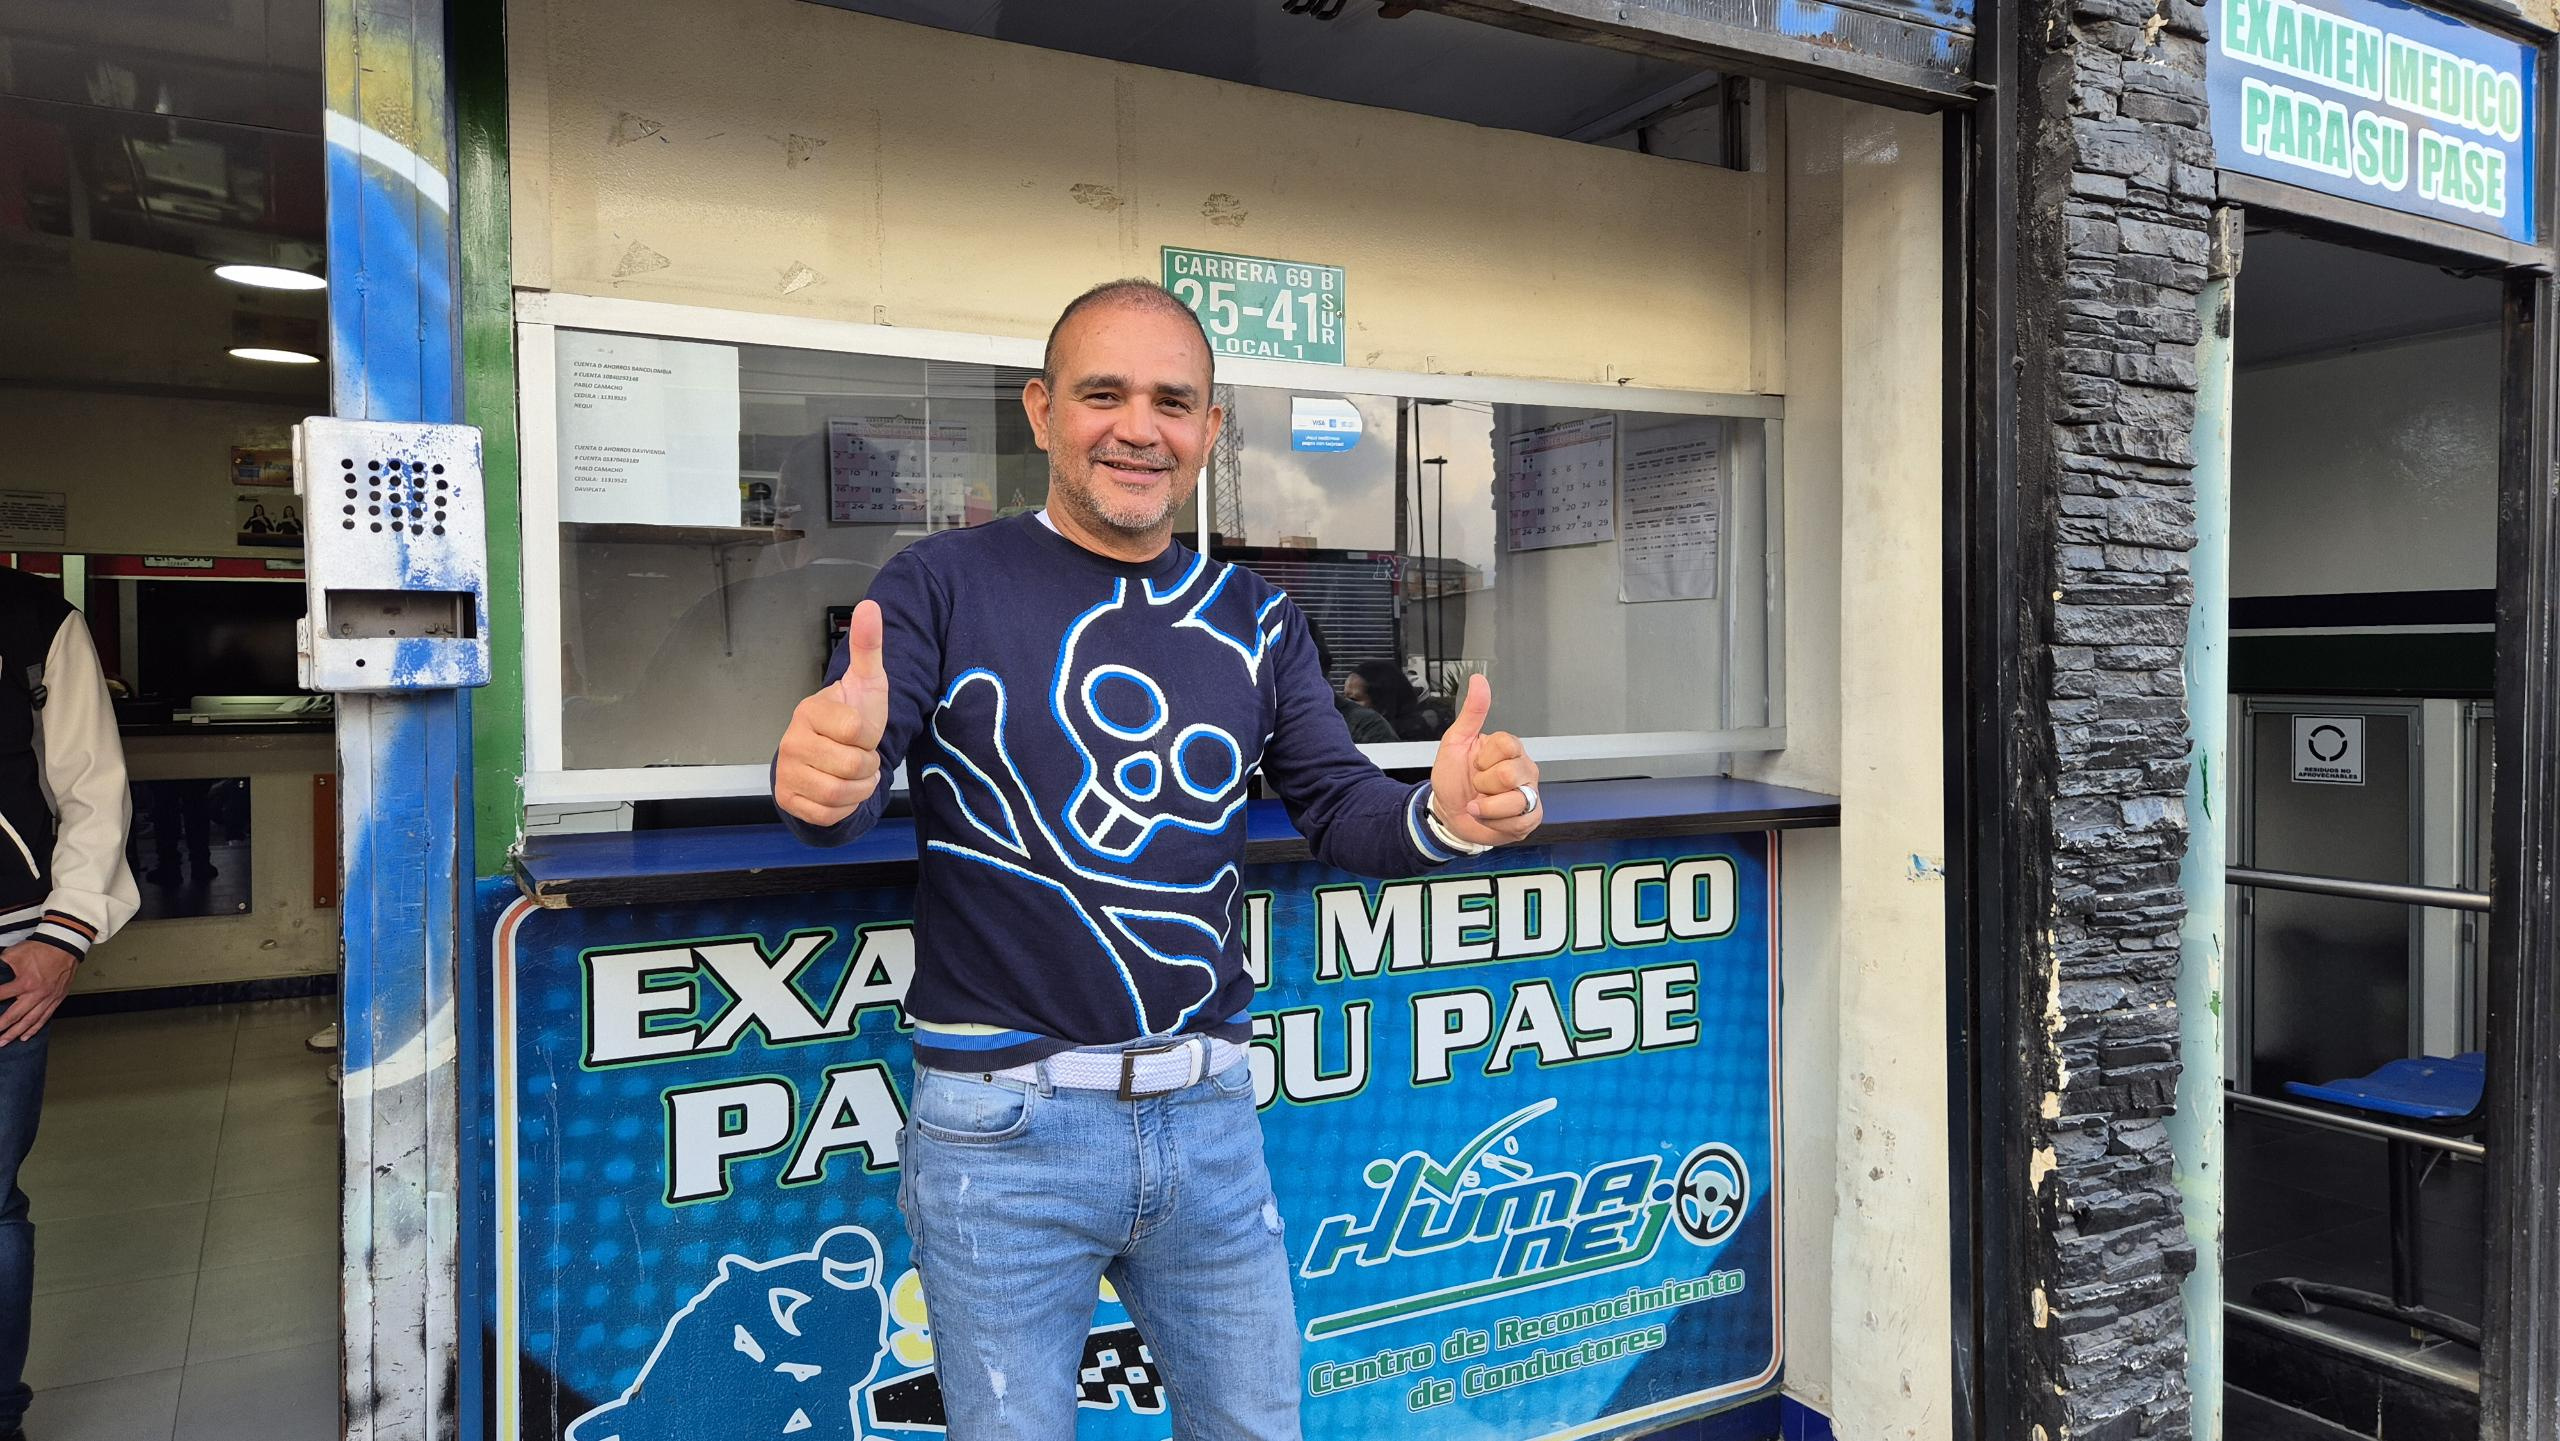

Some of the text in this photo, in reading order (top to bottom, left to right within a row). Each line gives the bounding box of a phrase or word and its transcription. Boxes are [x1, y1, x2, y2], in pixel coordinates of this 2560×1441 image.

[2223, 0, 2522, 141] EXAMEN MEDICO
[2243, 80, 2505, 216] PARA SU PASE
[1173, 278, 1318, 343] 25-41
[1174, 255, 1334, 291] CARRERA 69 B
[1212, 336, 1304, 359] LOCAL 1
[1314, 857, 1737, 983] MEDICO
[661, 1062, 909, 1204] PA
[1411, 962, 1700, 1086] PASE
[1309, 1268, 1745, 1396] Centro de Reconocimiento
[1407, 1324, 1667, 1412] de Conductores
